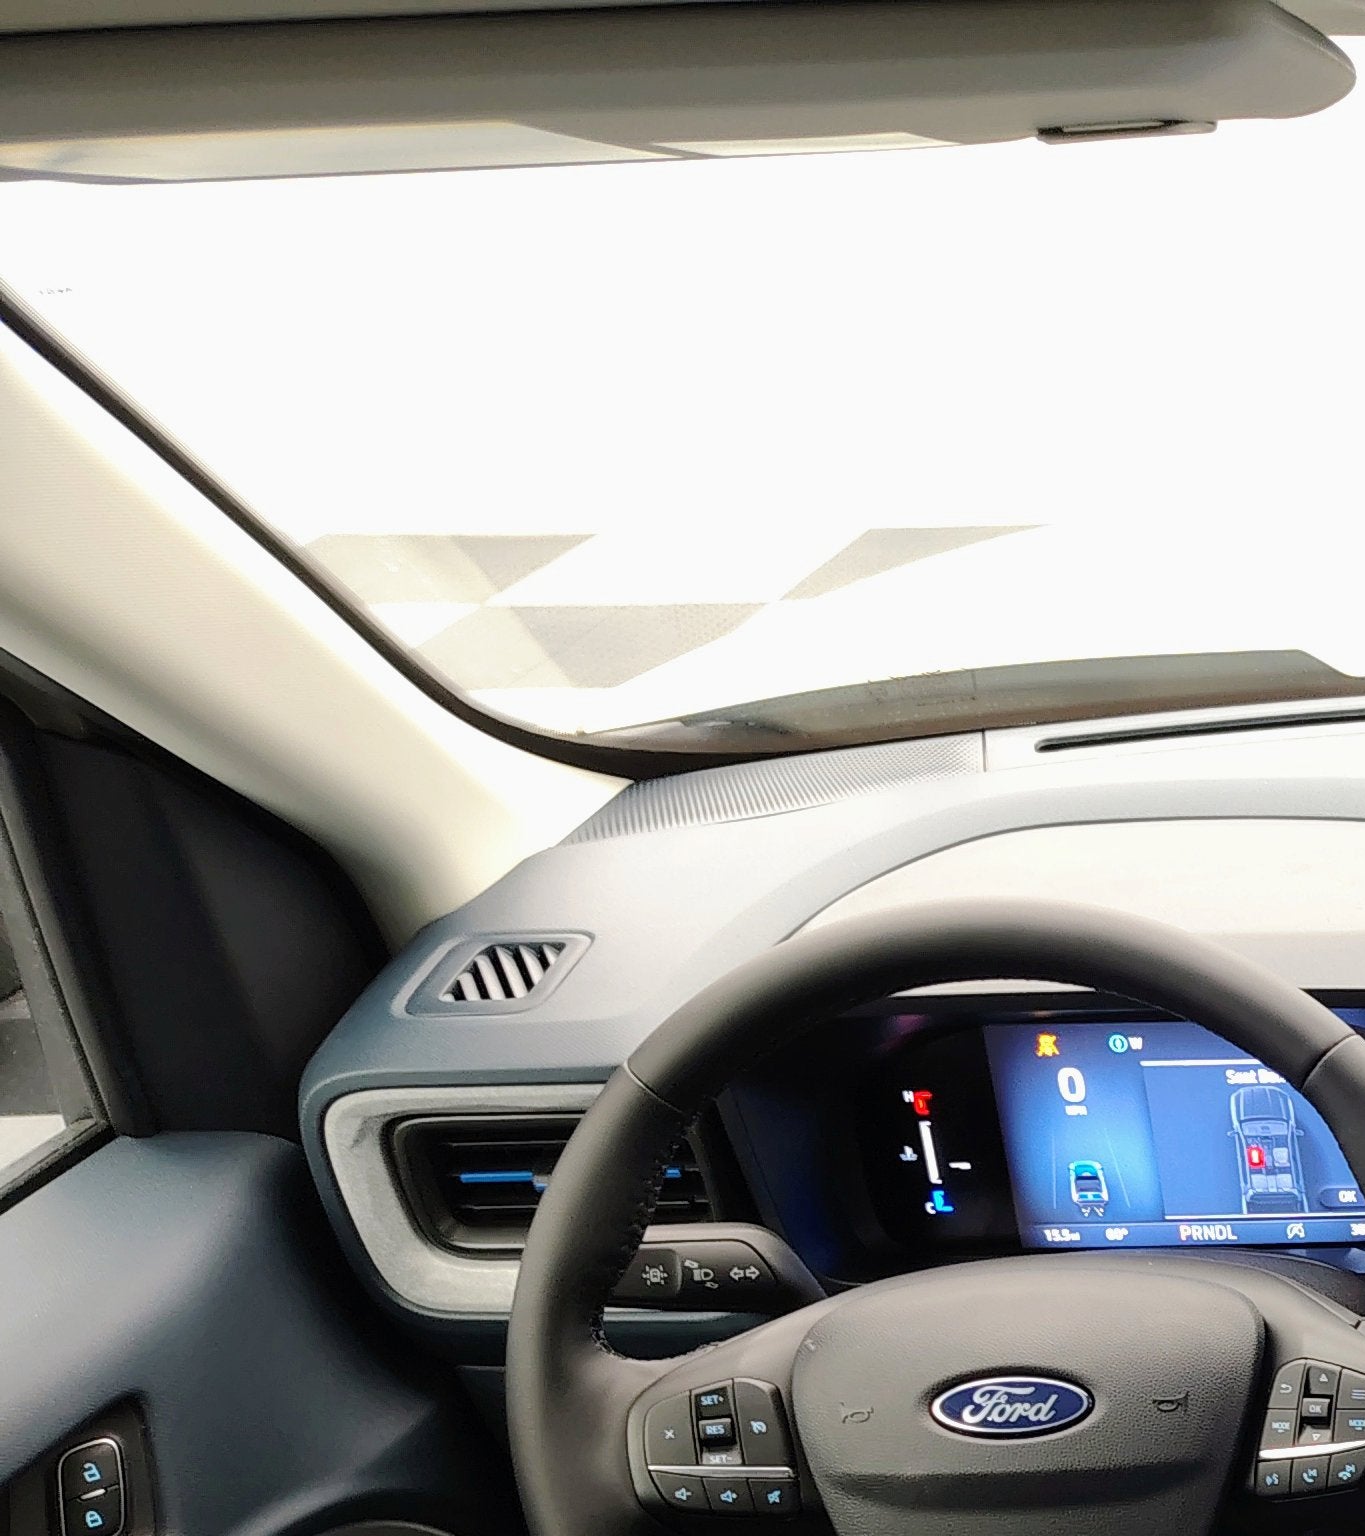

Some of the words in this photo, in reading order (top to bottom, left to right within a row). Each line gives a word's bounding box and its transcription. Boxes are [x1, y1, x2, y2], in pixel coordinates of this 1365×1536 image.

[1056, 1067, 1086, 1103] 0
[1338, 1190, 1358, 1203] OK
[1179, 1224, 1238, 1242] PRNDL
[961, 1385, 1059, 1424] Ford
[1308, 1404, 1322, 1413] OK
[705, 1424, 725, 1435] RES
